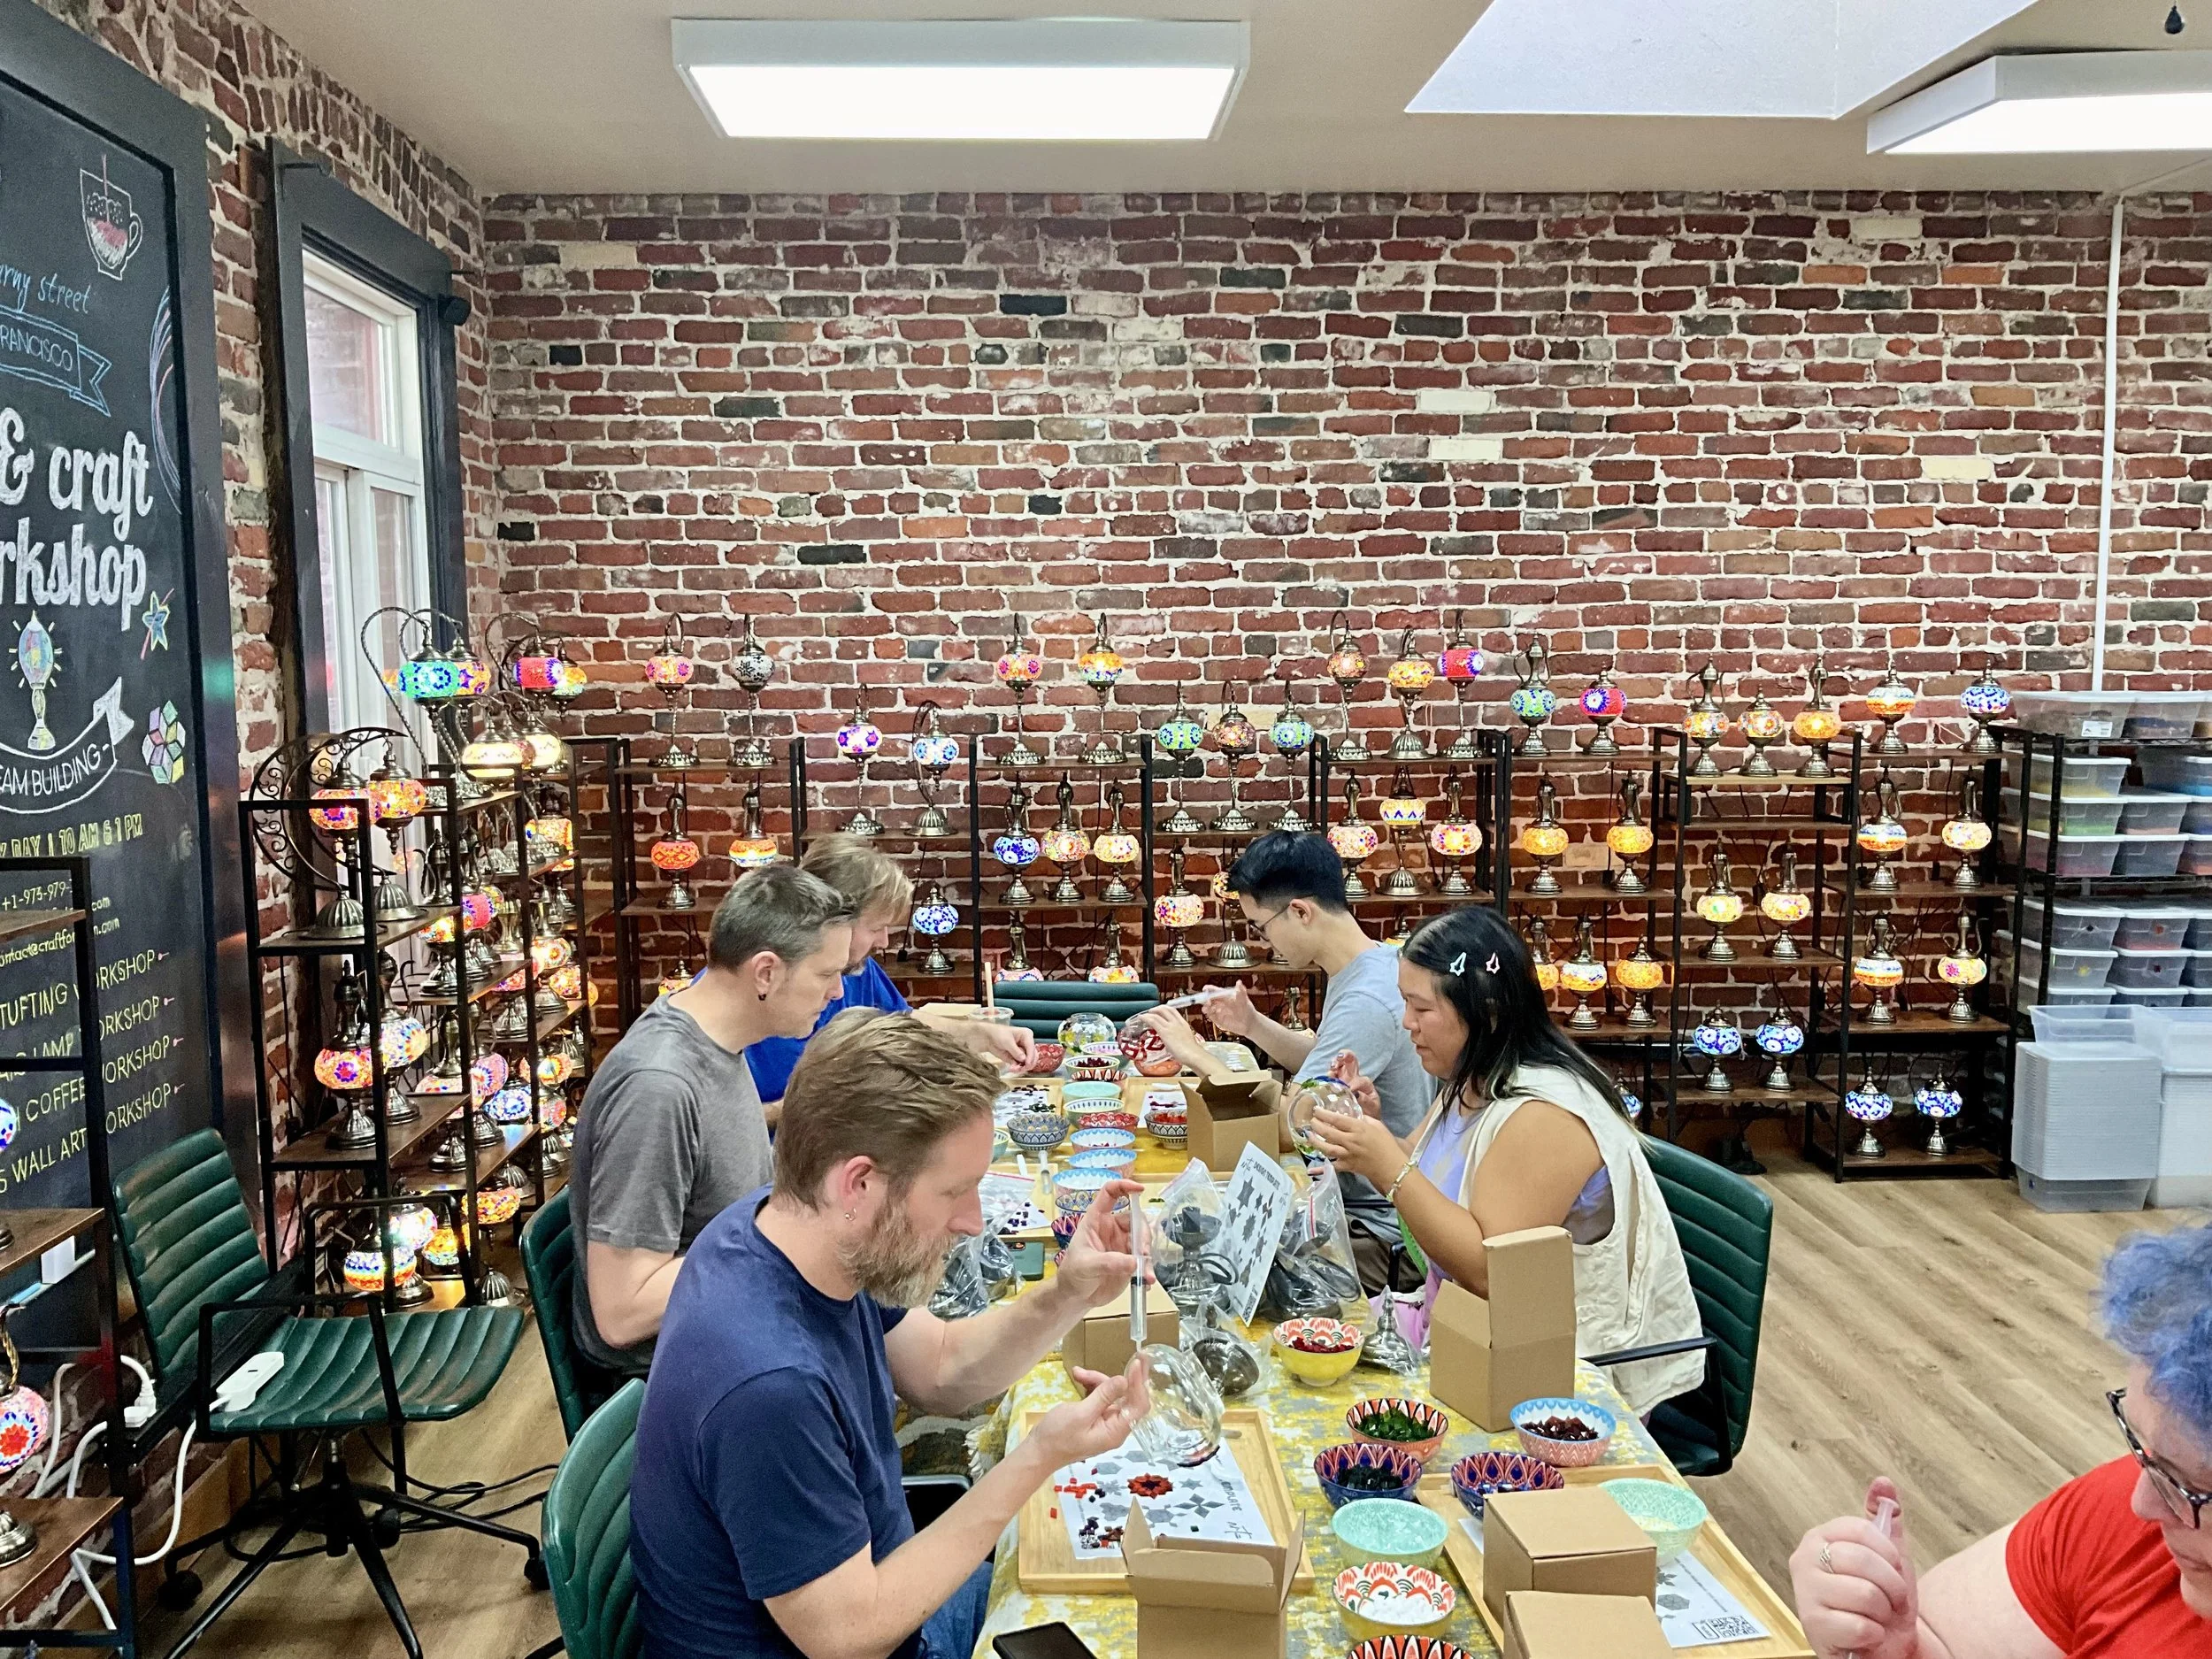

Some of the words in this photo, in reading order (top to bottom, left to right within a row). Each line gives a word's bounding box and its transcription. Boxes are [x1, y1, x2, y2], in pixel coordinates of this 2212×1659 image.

[38, 273, 91, 314] street
[0, 407, 35, 505] &
[49, 431, 154, 541] craft
[0, 517, 147, 631] rkshop
[12, 834, 41, 857] DAY
[58, 826, 75, 856] 10
[78, 823, 99, 852] AM
[115, 817, 122, 842] 1
[124, 813, 143, 841] PM
[0, 982, 67, 1030] TUFTING
[25, 1076, 86, 1122] COFFEE
[102, 1035, 170, 1083] ORKSHOP
[11, 1145, 57, 1183] WALL
[60, 1127, 87, 1162] ART
